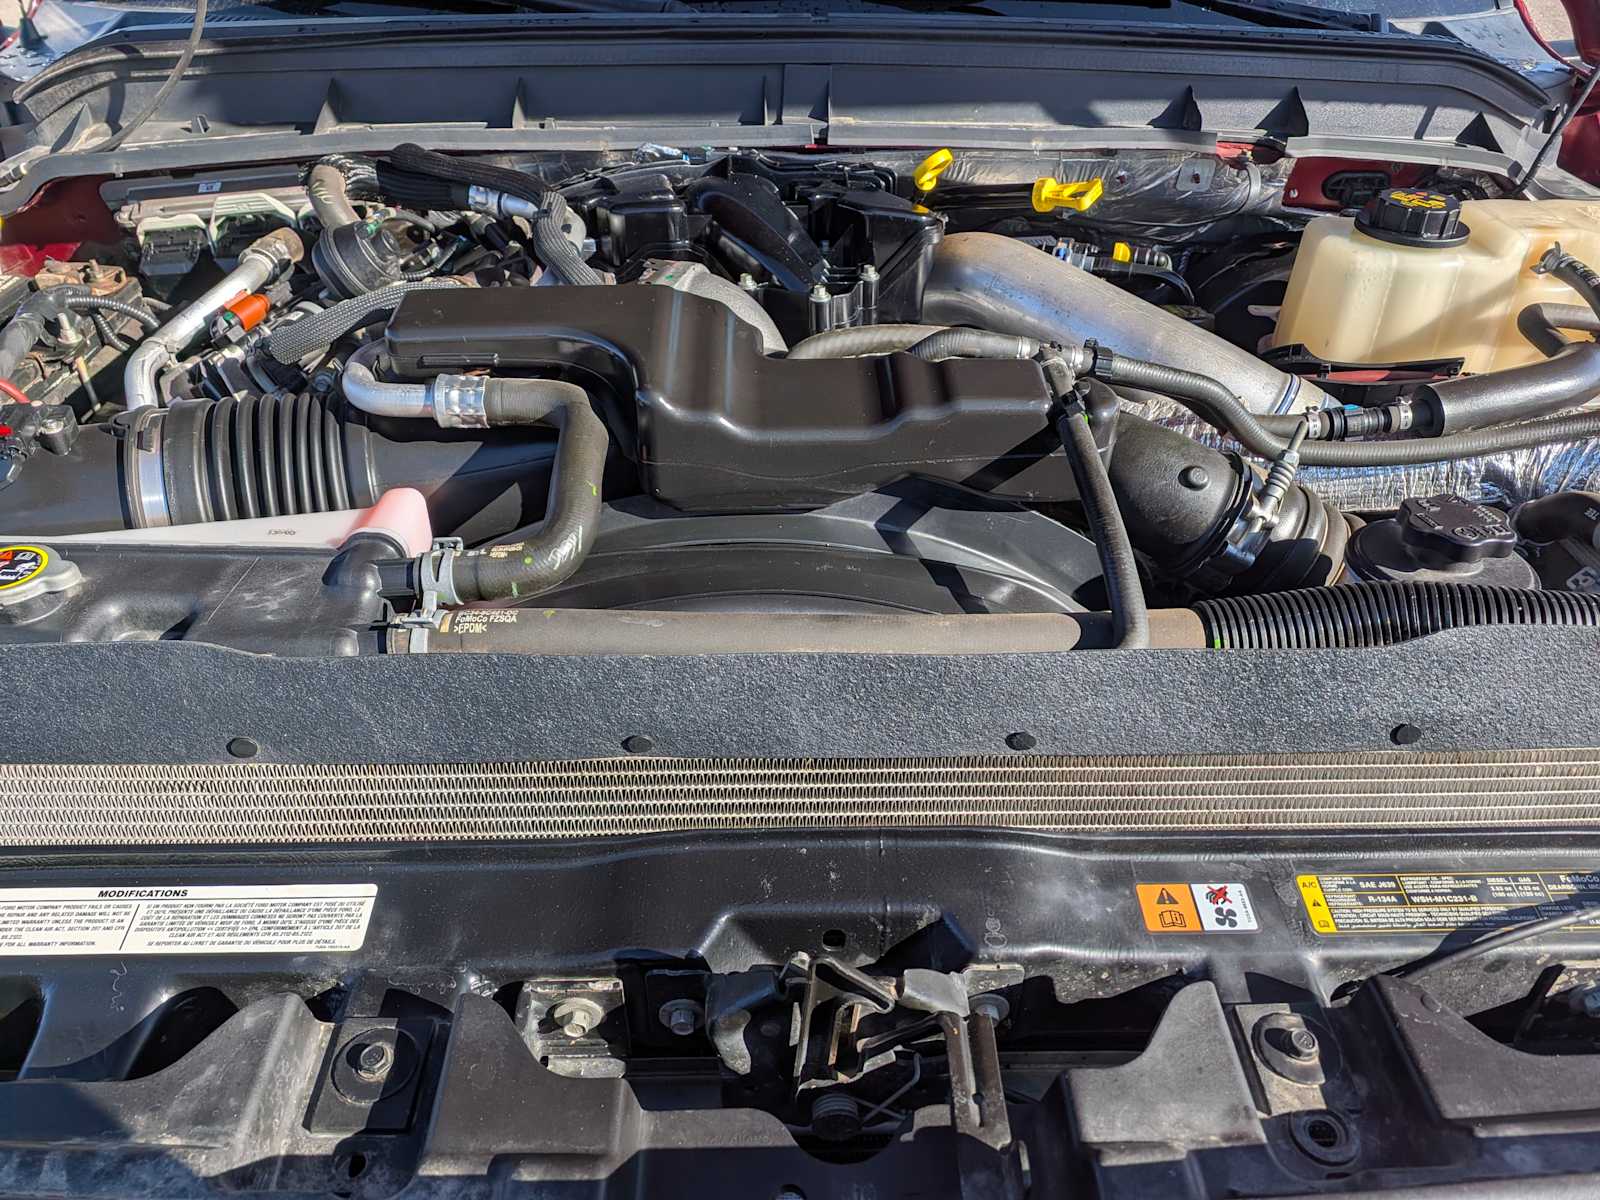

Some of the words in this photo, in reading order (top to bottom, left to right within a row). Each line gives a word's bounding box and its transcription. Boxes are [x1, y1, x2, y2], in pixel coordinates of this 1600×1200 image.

[454, 622, 487, 634] >EPDM<
[98, 889, 188, 898] MODIFICATIONS
[1367, 895, 1398, 903] R-134A
